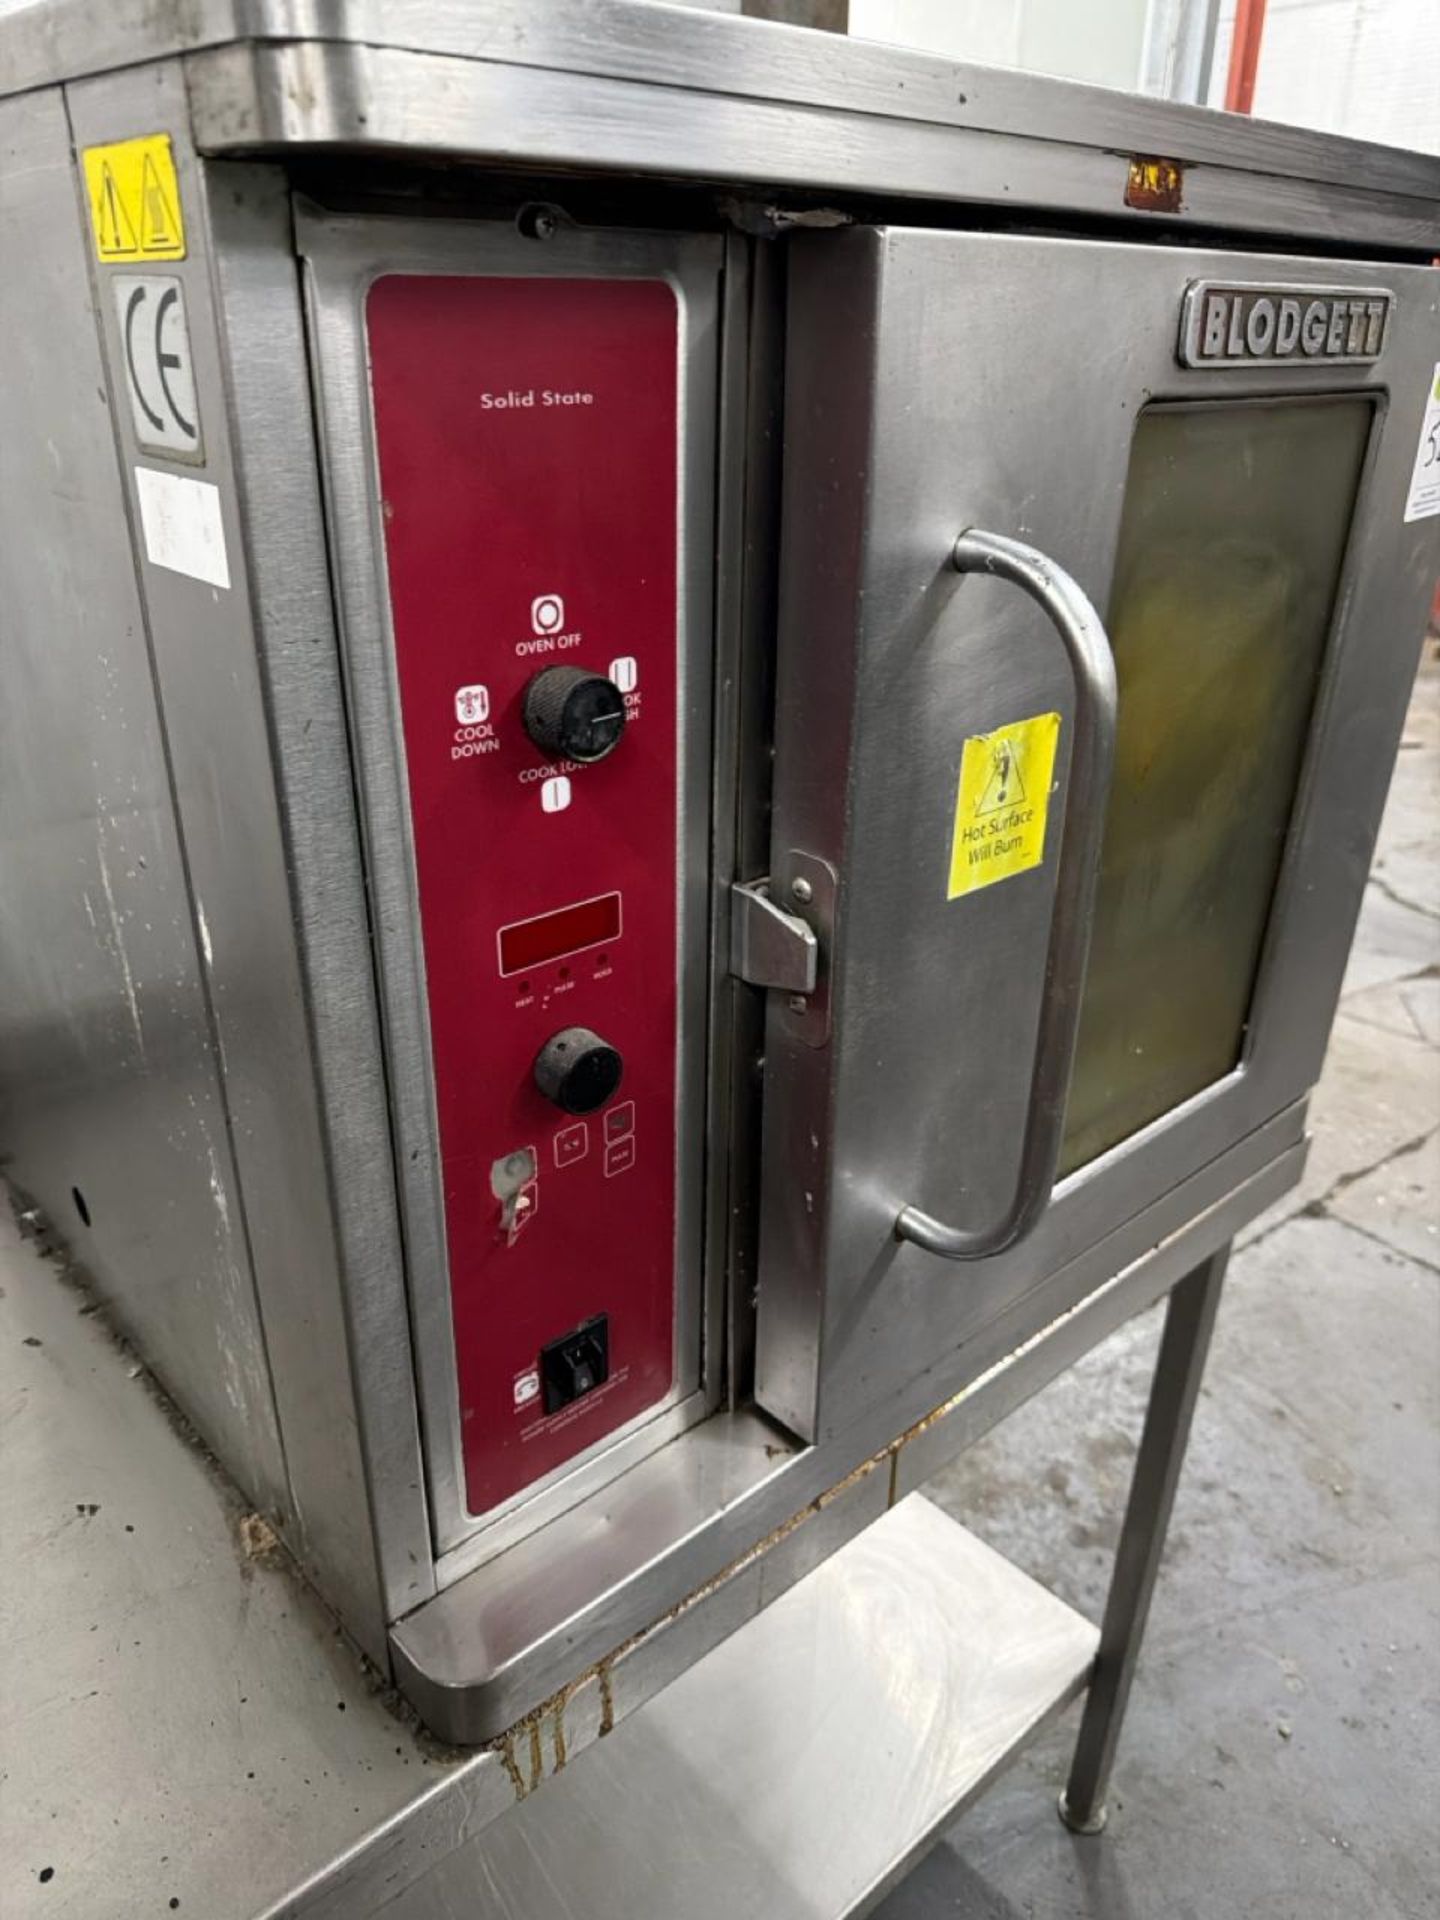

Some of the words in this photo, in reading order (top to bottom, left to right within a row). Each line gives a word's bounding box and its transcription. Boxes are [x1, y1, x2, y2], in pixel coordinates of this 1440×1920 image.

[1203, 296, 1384, 355] BLODGETT
[126, 285, 197, 439] CE
[480, 390, 535, 409] Solid
[541, 390, 594, 406] State
[515, 637, 555, 657] OVEN
[557, 633, 582, 649] OFF
[454, 723, 495, 742] COOL
[450, 738, 500, 760] DOWN
[518, 764, 558, 783] COOK
[962, 824, 986, 844] Hot
[987, 809, 1034, 835] Surface
[968, 842, 992, 865] Will
